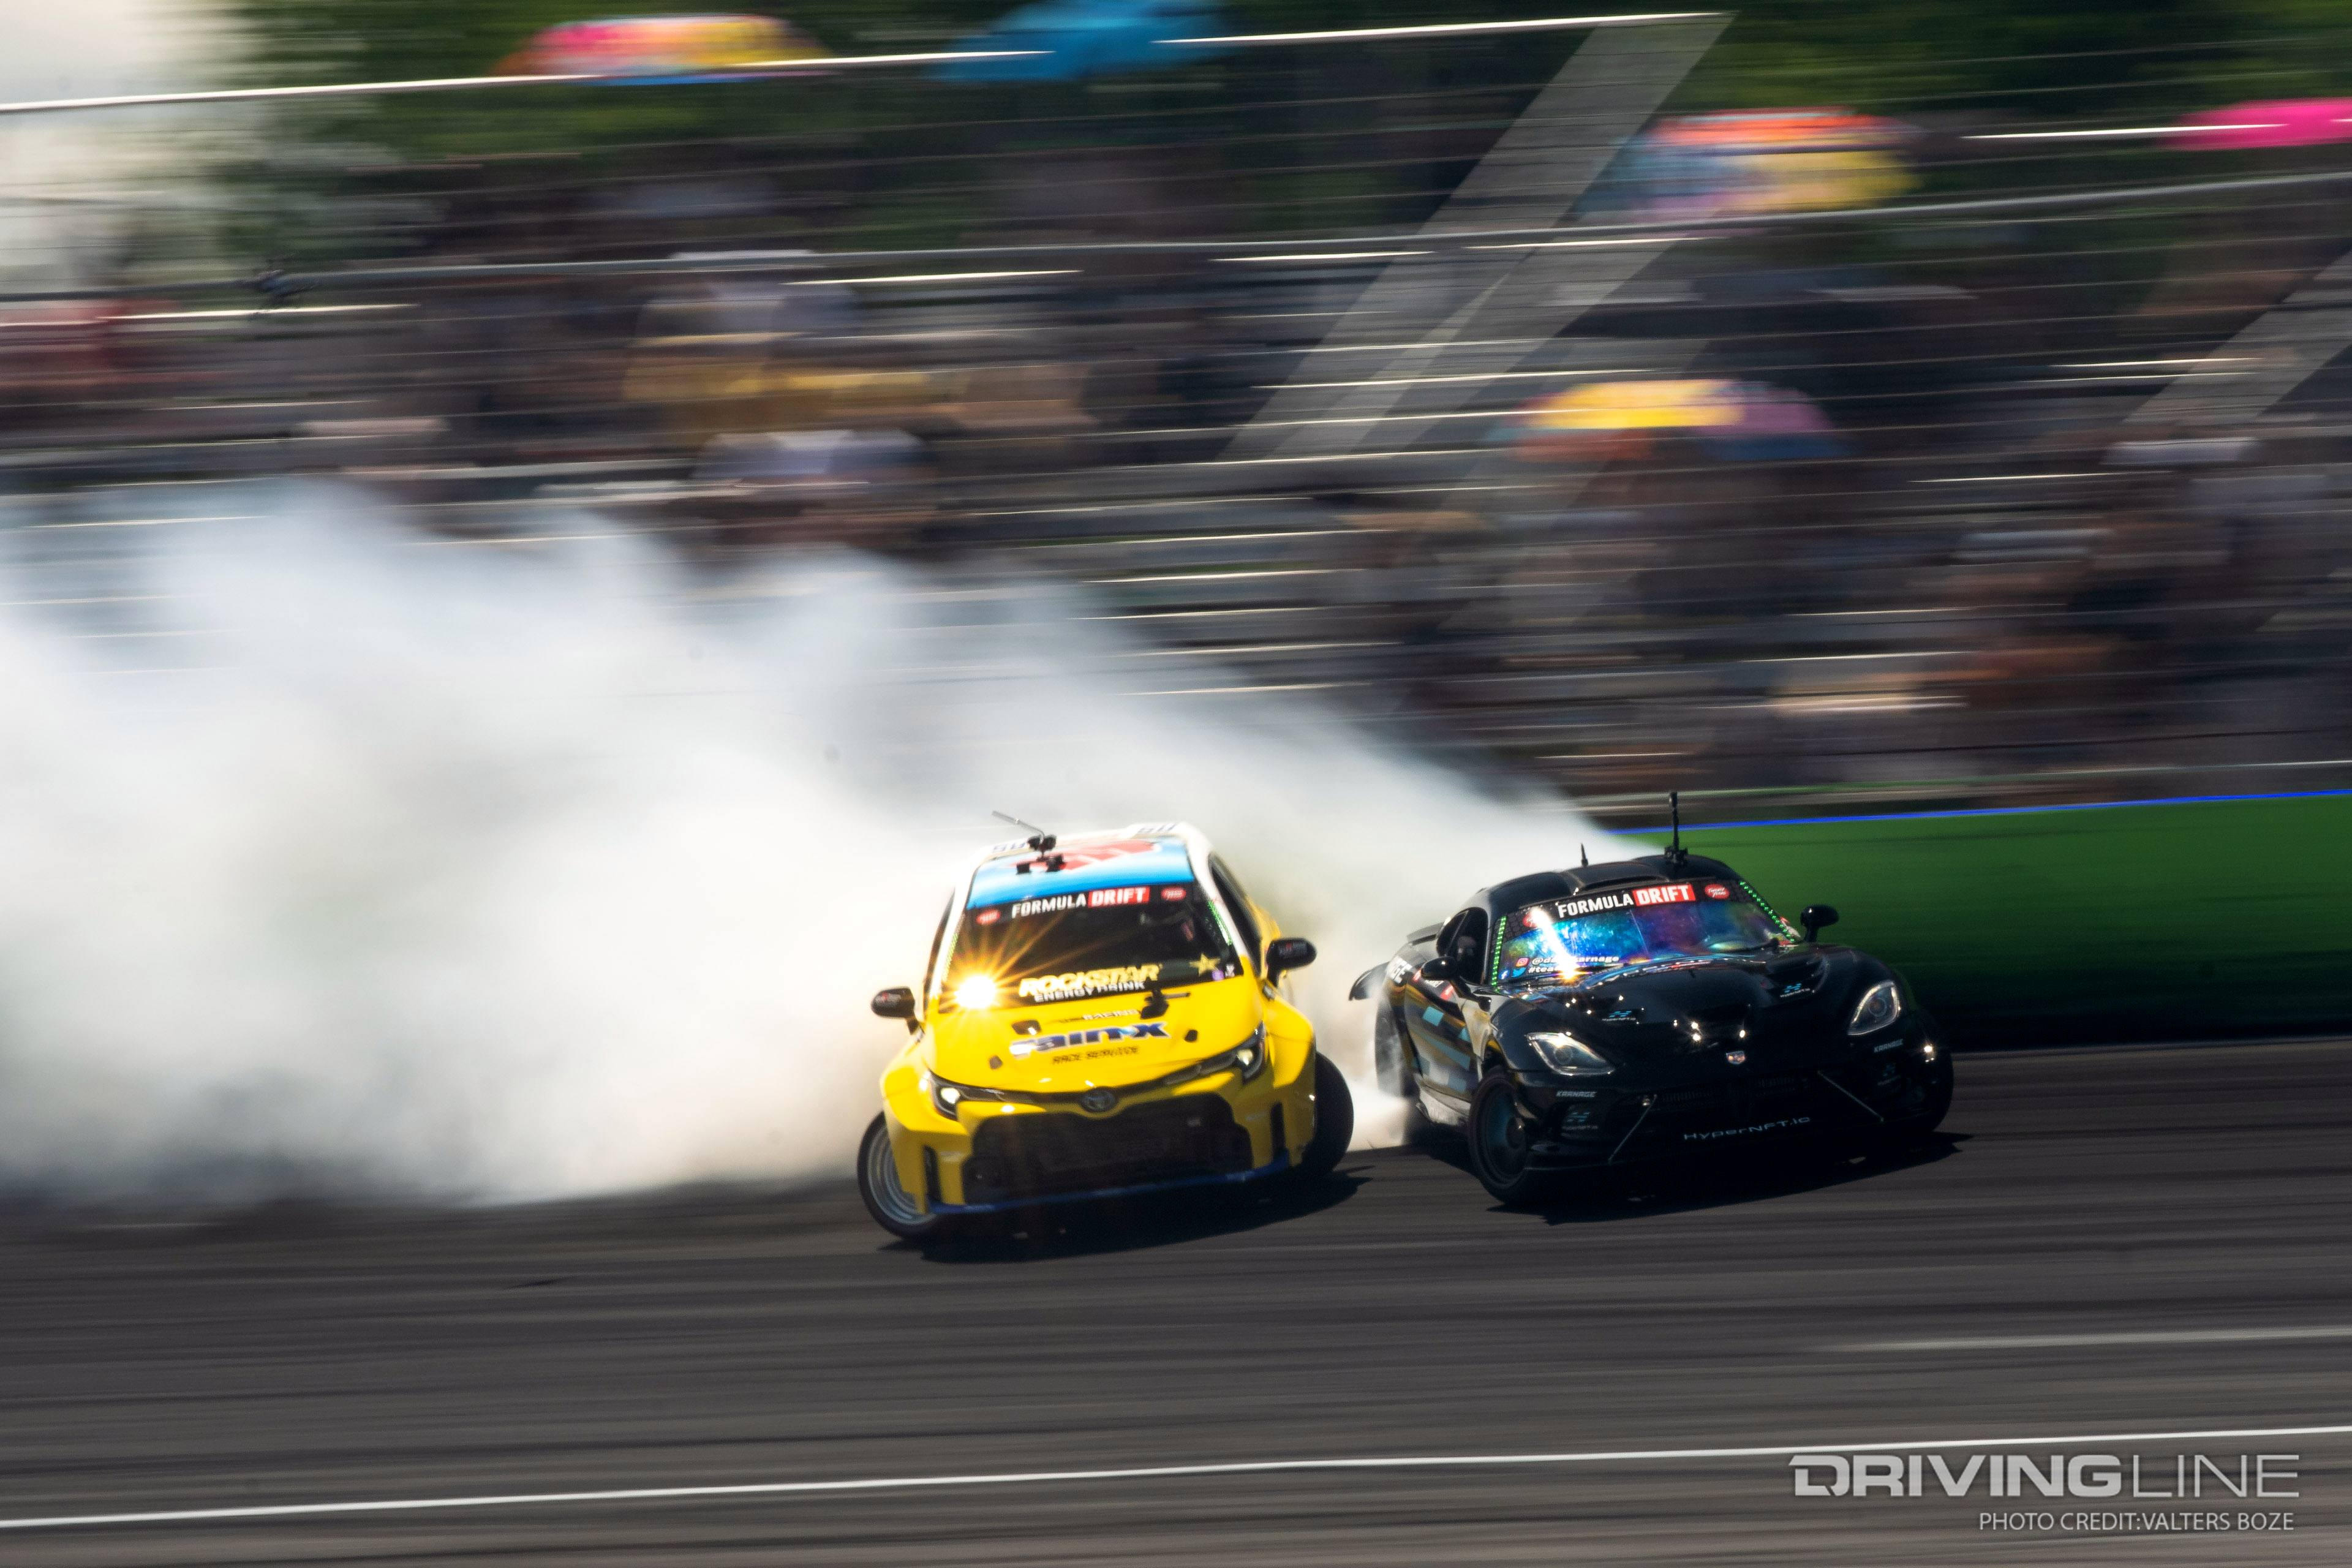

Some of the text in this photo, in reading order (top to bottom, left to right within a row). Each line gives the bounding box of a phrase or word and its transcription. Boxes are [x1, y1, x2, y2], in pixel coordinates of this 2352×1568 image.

[1011, 892, 1087, 919] FORMULA
[1091, 888, 1147, 906] DRIFT
[1558, 893, 1634, 918] FORMULA
[1637, 884, 1690, 903] DRIFT
[1019, 964, 1160, 997] ROCKSTAR
[1035, 981, 1145, 1003] ENERGY DRINK
